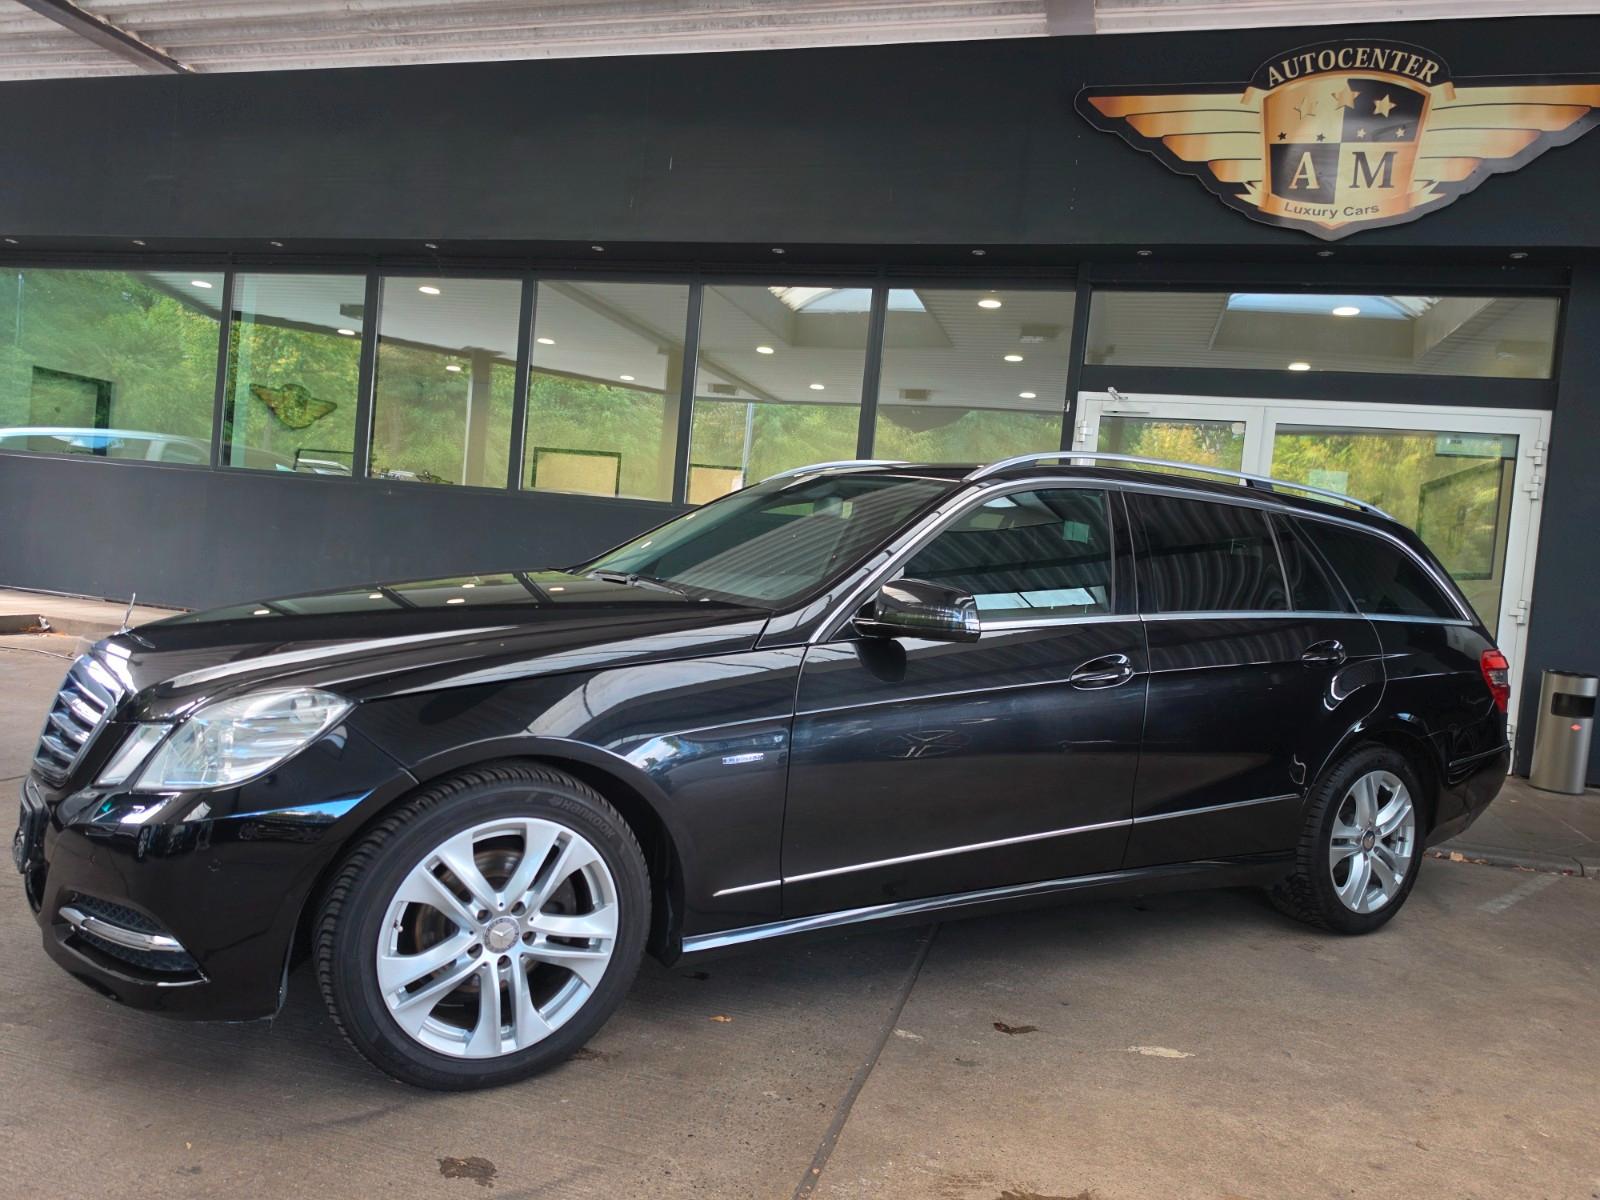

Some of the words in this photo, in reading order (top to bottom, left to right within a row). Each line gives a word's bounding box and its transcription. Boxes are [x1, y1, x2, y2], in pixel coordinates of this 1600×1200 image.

[1267, 47, 1440, 87] AUTOCENTER
[1288, 151, 1321, 190] A
[1348, 151, 1398, 189] M
[1284, 201, 1338, 219] Luxury
[1343, 203, 1380, 217] Cars
